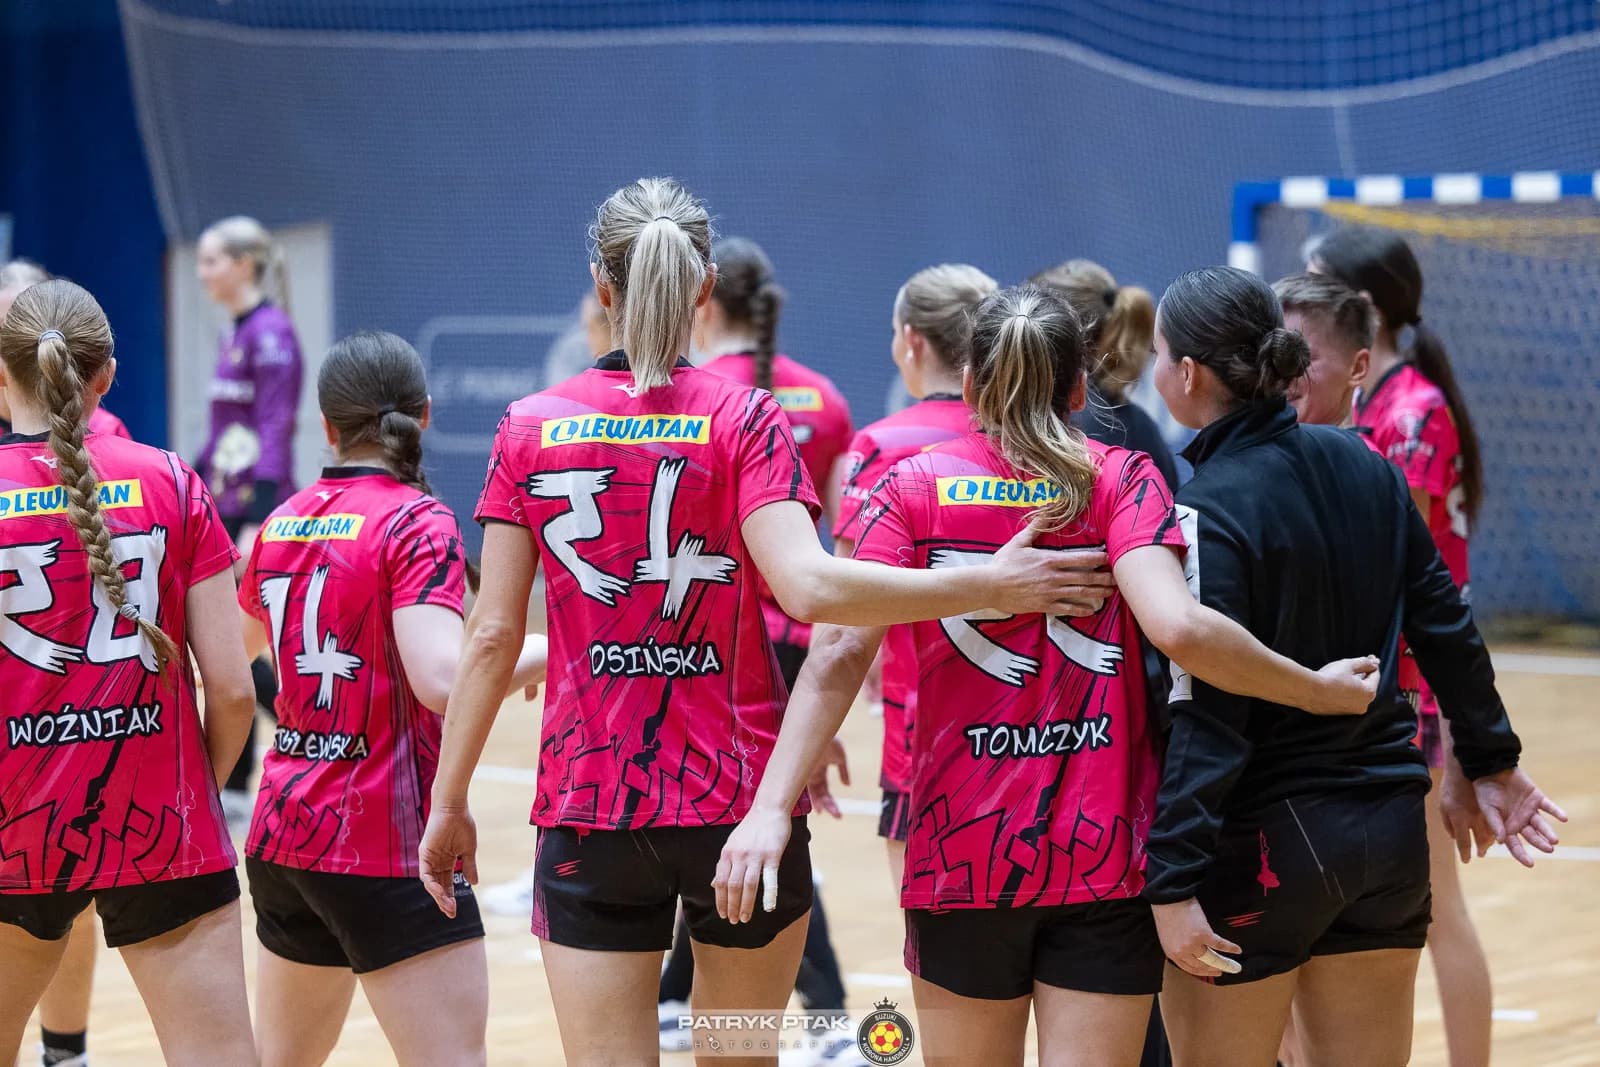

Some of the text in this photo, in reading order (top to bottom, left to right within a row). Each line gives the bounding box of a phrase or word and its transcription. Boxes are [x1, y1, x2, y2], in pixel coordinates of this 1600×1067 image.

[580, 416, 703, 440] LEWIATAN
[14, 484, 131, 513] LEWIAN
[526, 456, 739, 623] 24
[259, 563, 365, 712] 14
[592, 639, 720, 674] OSIŃSKA
[8, 703, 162, 746] WOŹNIAK
[967, 716, 1110, 756] TOMCZYK
